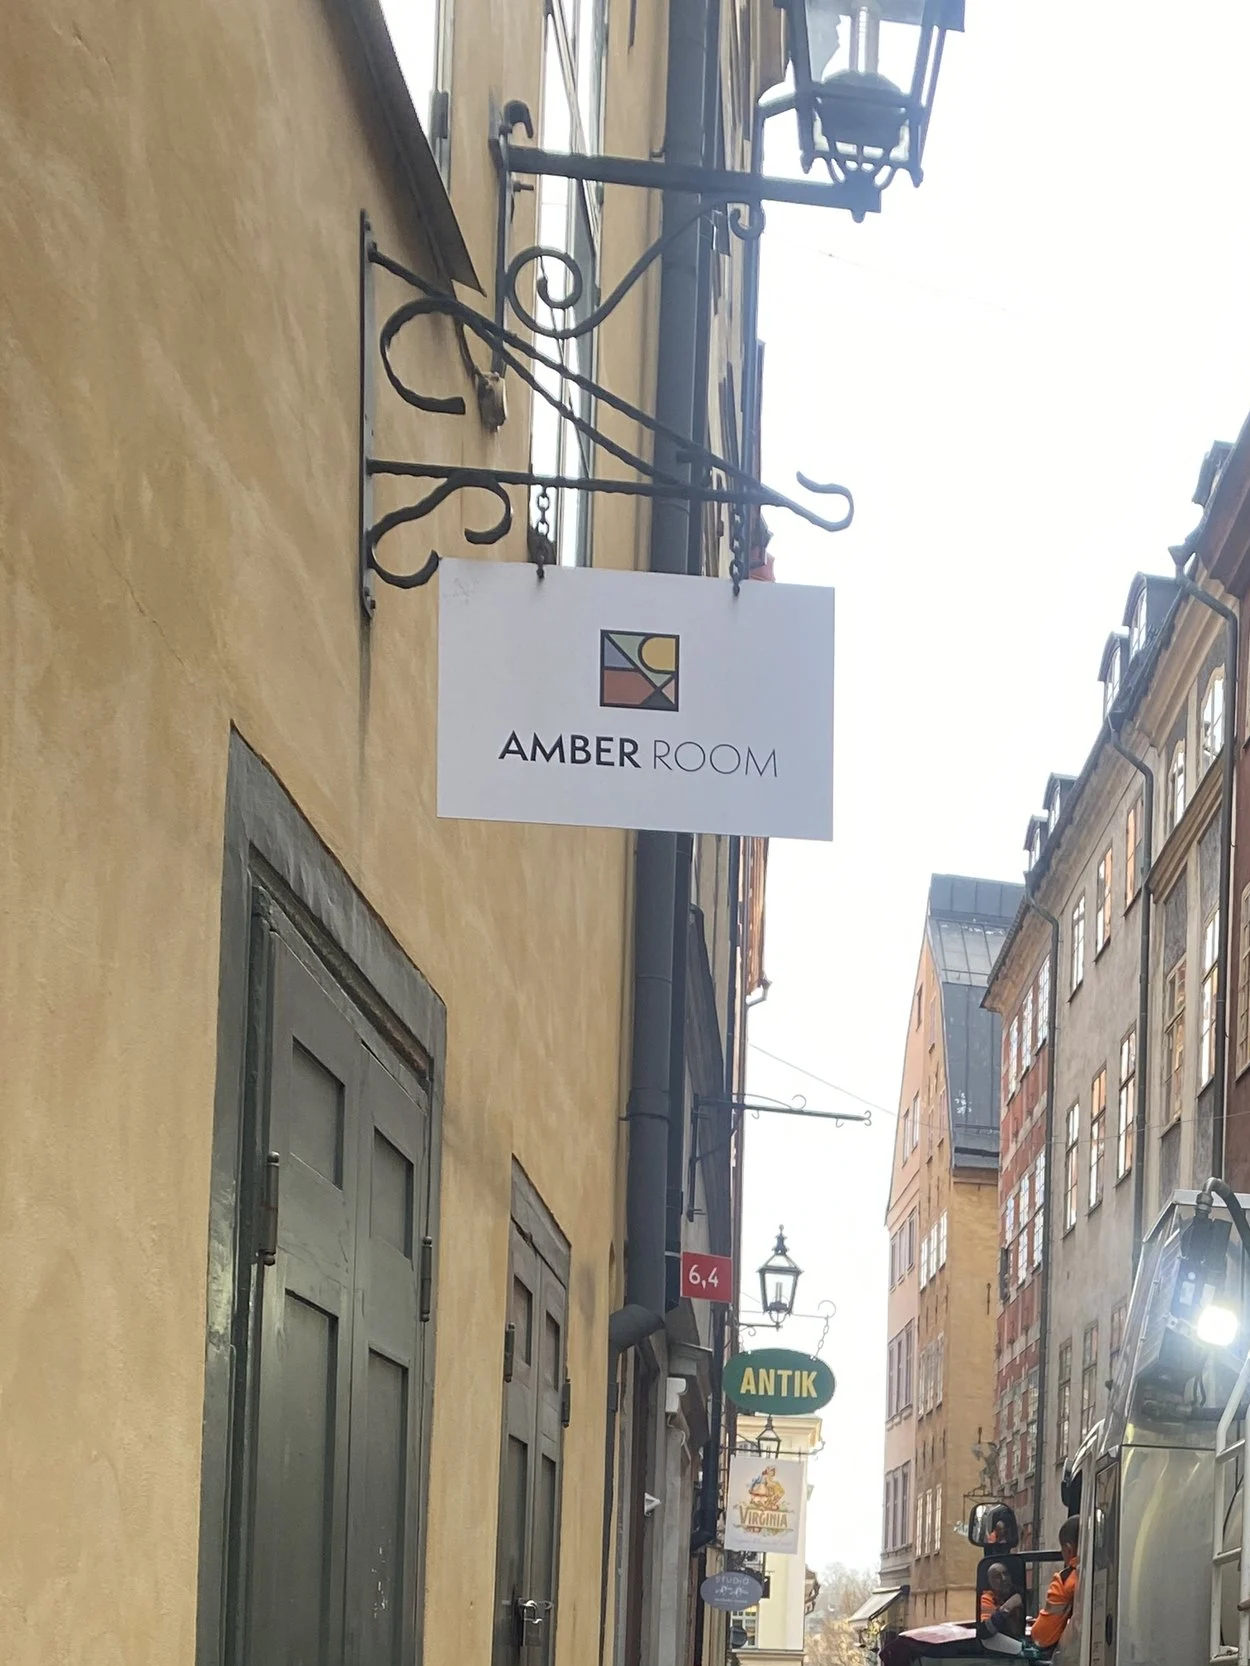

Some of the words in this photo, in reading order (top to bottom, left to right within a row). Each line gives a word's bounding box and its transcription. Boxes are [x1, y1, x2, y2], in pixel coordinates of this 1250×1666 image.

[498, 730, 641, 769] AMBER
[653, 740, 778, 778] ROOM
[688, 1264, 719, 1289] 6,4
[740, 1367, 818, 1398] ANTIK
[740, 1504, 788, 1529] VIRGINIA
